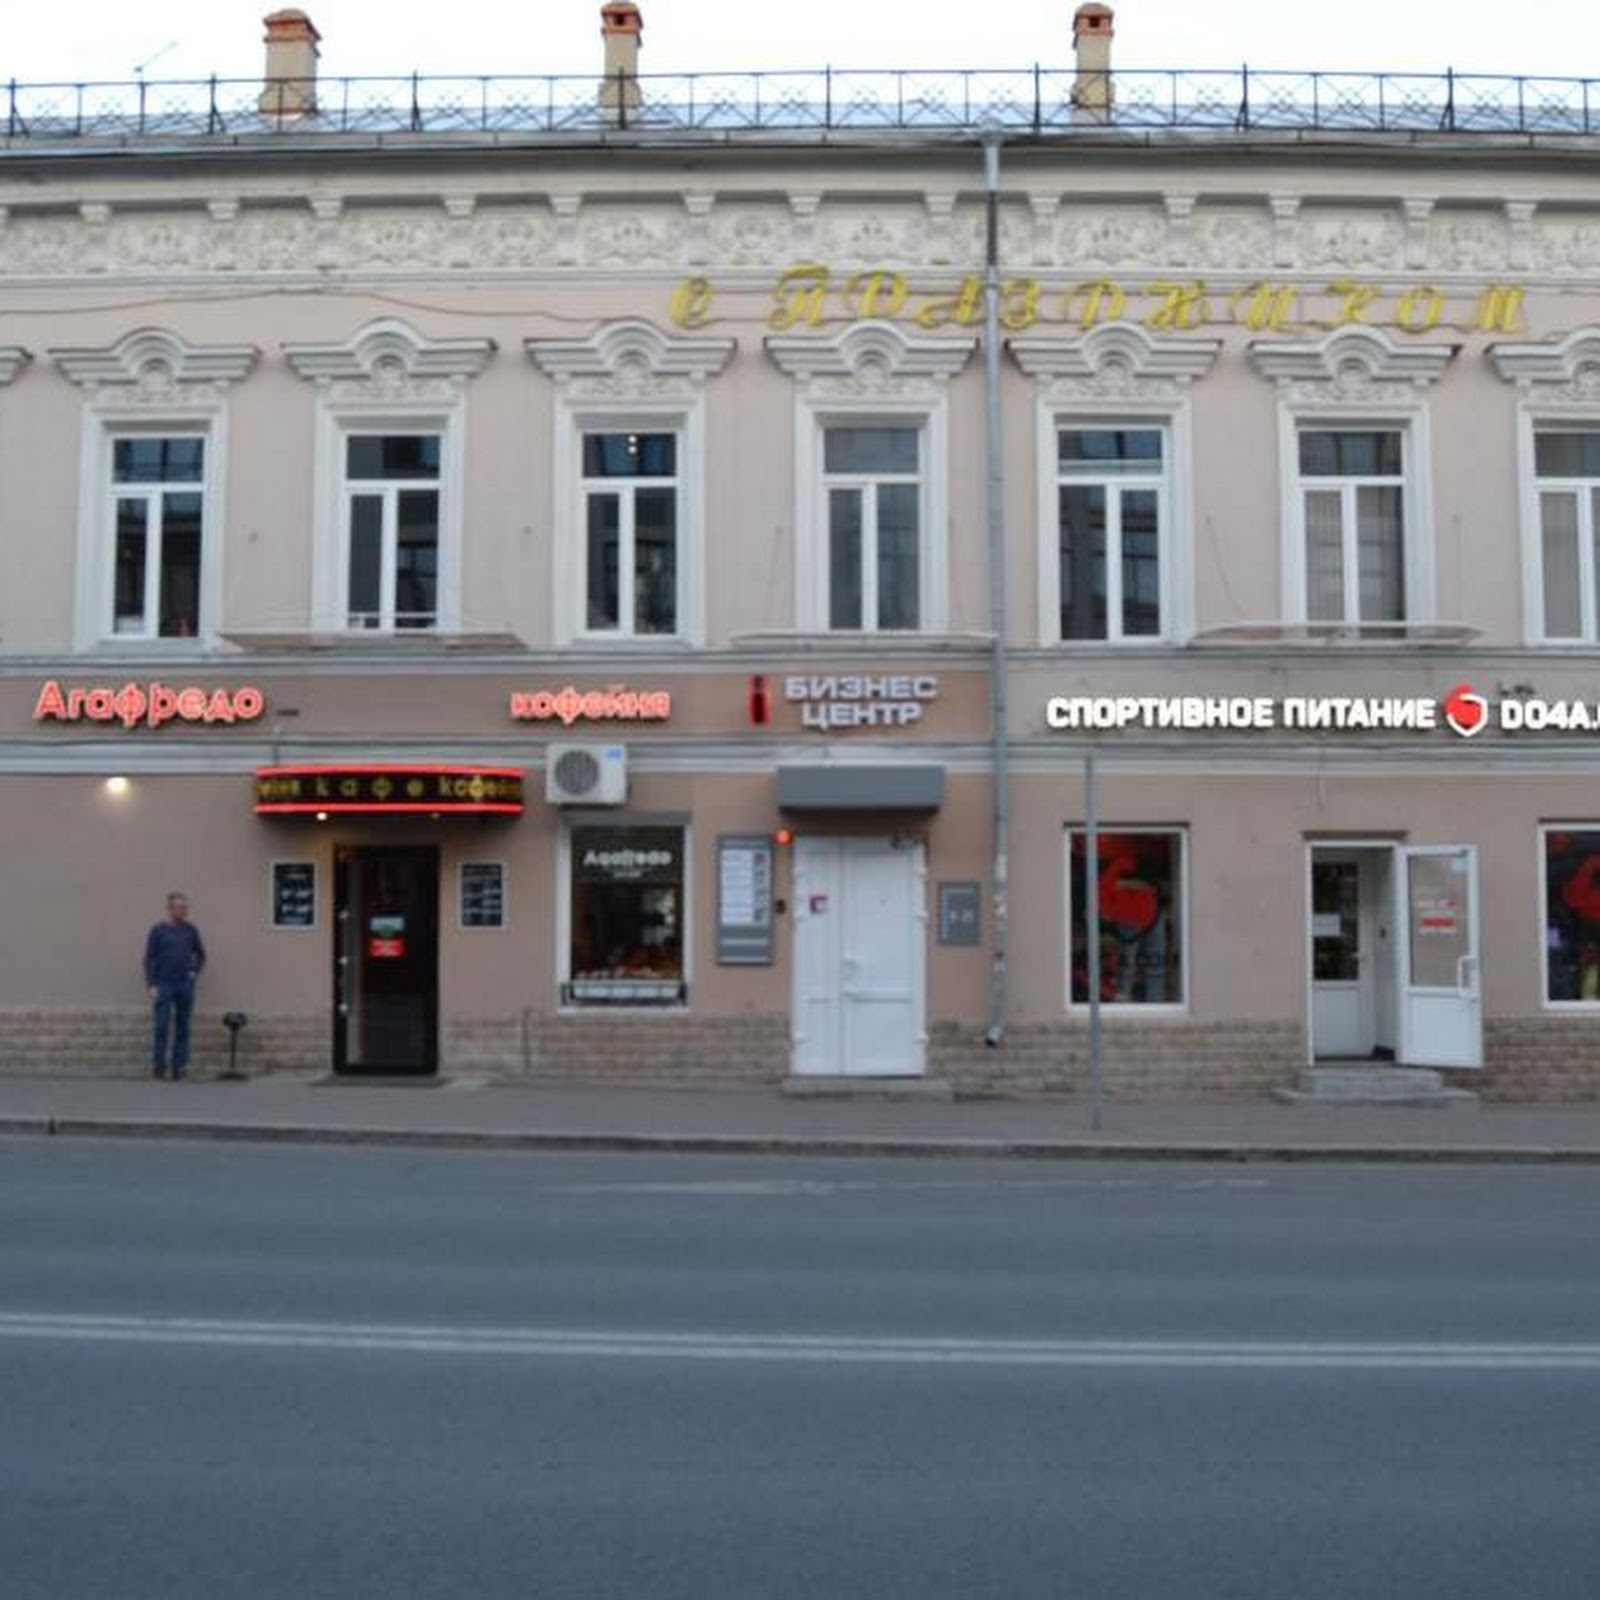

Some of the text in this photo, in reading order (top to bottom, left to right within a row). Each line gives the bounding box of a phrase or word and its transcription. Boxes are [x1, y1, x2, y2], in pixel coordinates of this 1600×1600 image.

[784, 675, 938, 699] БИЗНЕС
[33, 680, 264, 728] Агафредо
[510, 685, 671, 725] кофейня
[802, 702, 922, 730] ЦЕНТР
[1046, 697, 1437, 729] СПОРТИВНОЕ ПИТАНИЕ
[1500, 699, 1600, 730] DO4A.
